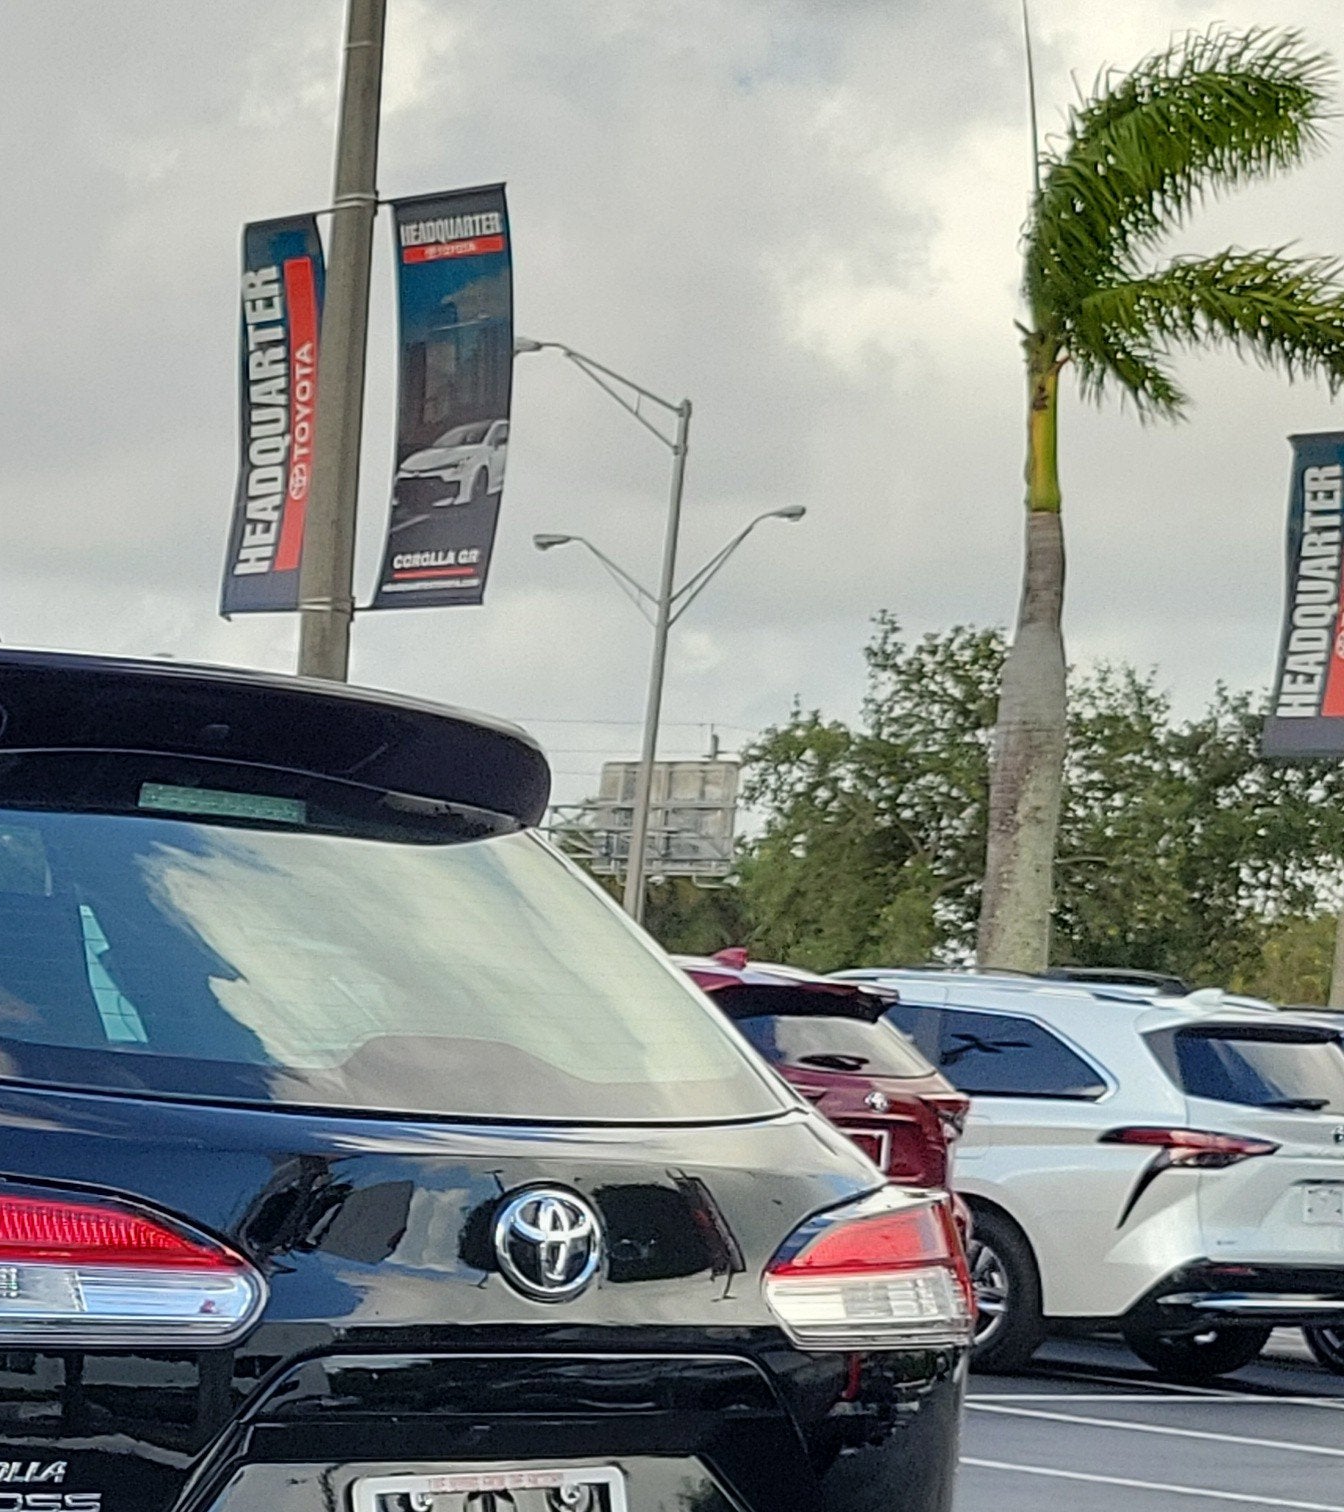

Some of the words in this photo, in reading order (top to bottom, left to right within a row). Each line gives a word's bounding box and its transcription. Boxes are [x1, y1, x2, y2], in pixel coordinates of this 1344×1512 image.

[233, 265, 291, 577] HEADQUARTER
[292, 341, 314, 462] TOYOTA
[1276, 463, 1344, 717] HEADQUARTER
